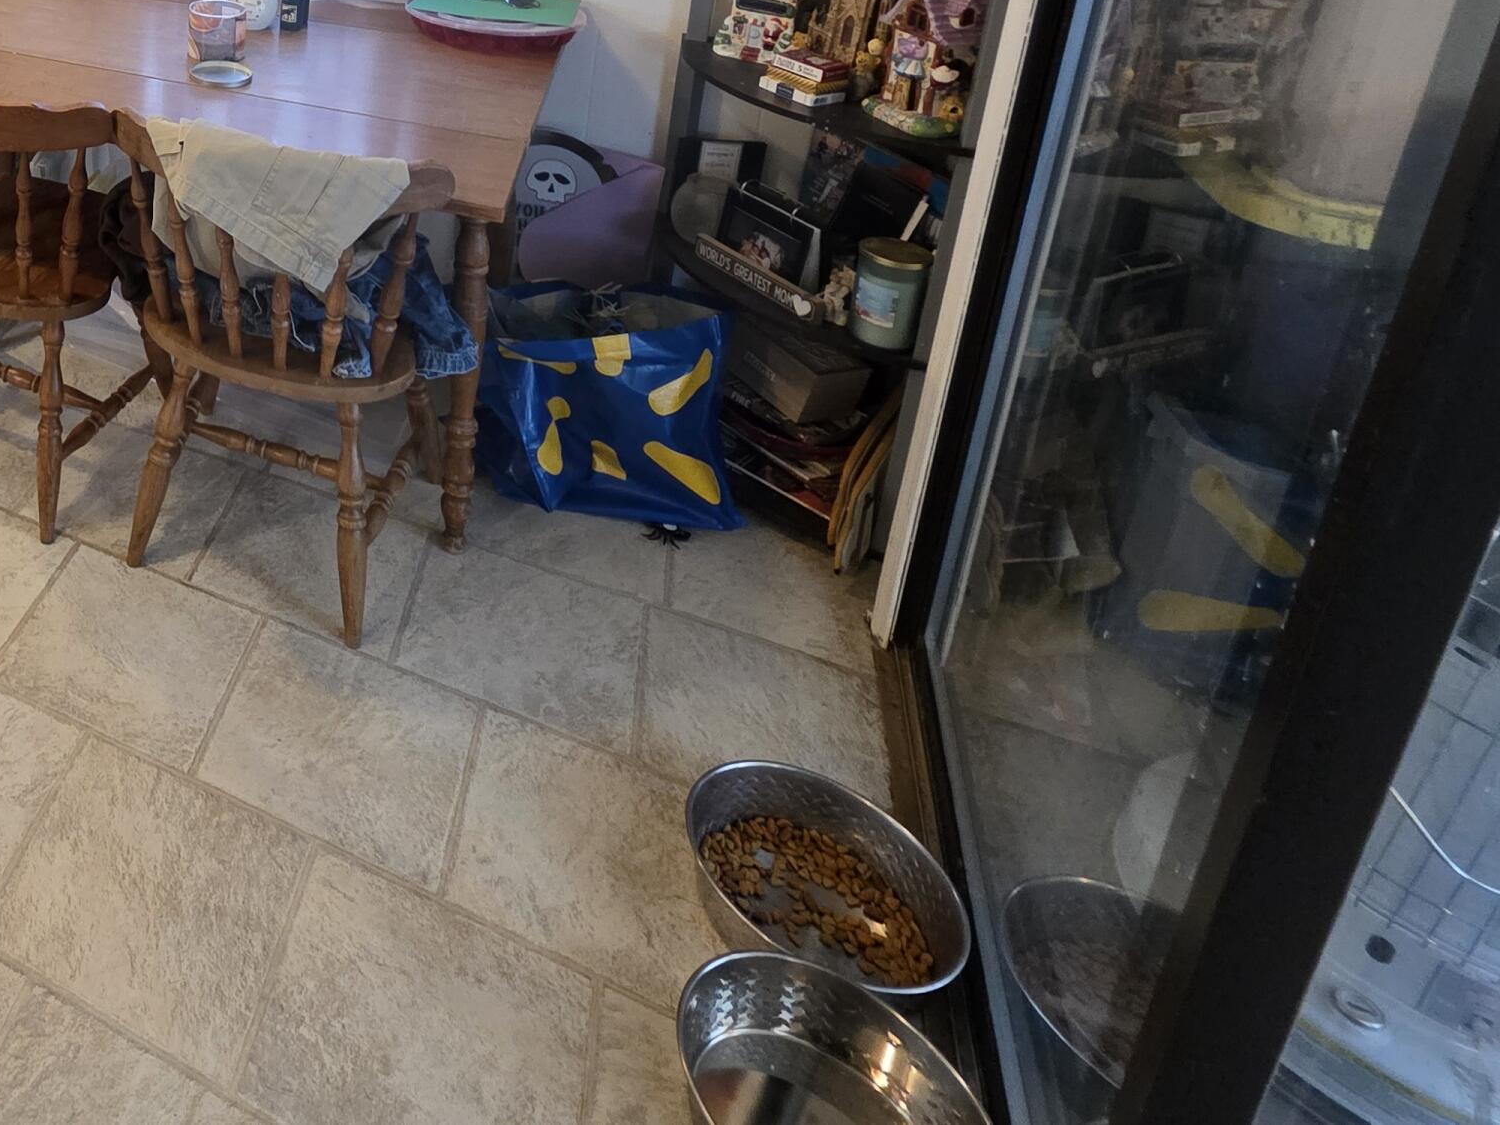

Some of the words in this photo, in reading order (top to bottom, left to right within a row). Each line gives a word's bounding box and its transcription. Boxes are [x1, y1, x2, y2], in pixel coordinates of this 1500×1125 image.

[700, 242, 731, 271] WORLD'S
[733, 263, 772, 294] GREATEST
[774, 285, 796, 308] MOM
